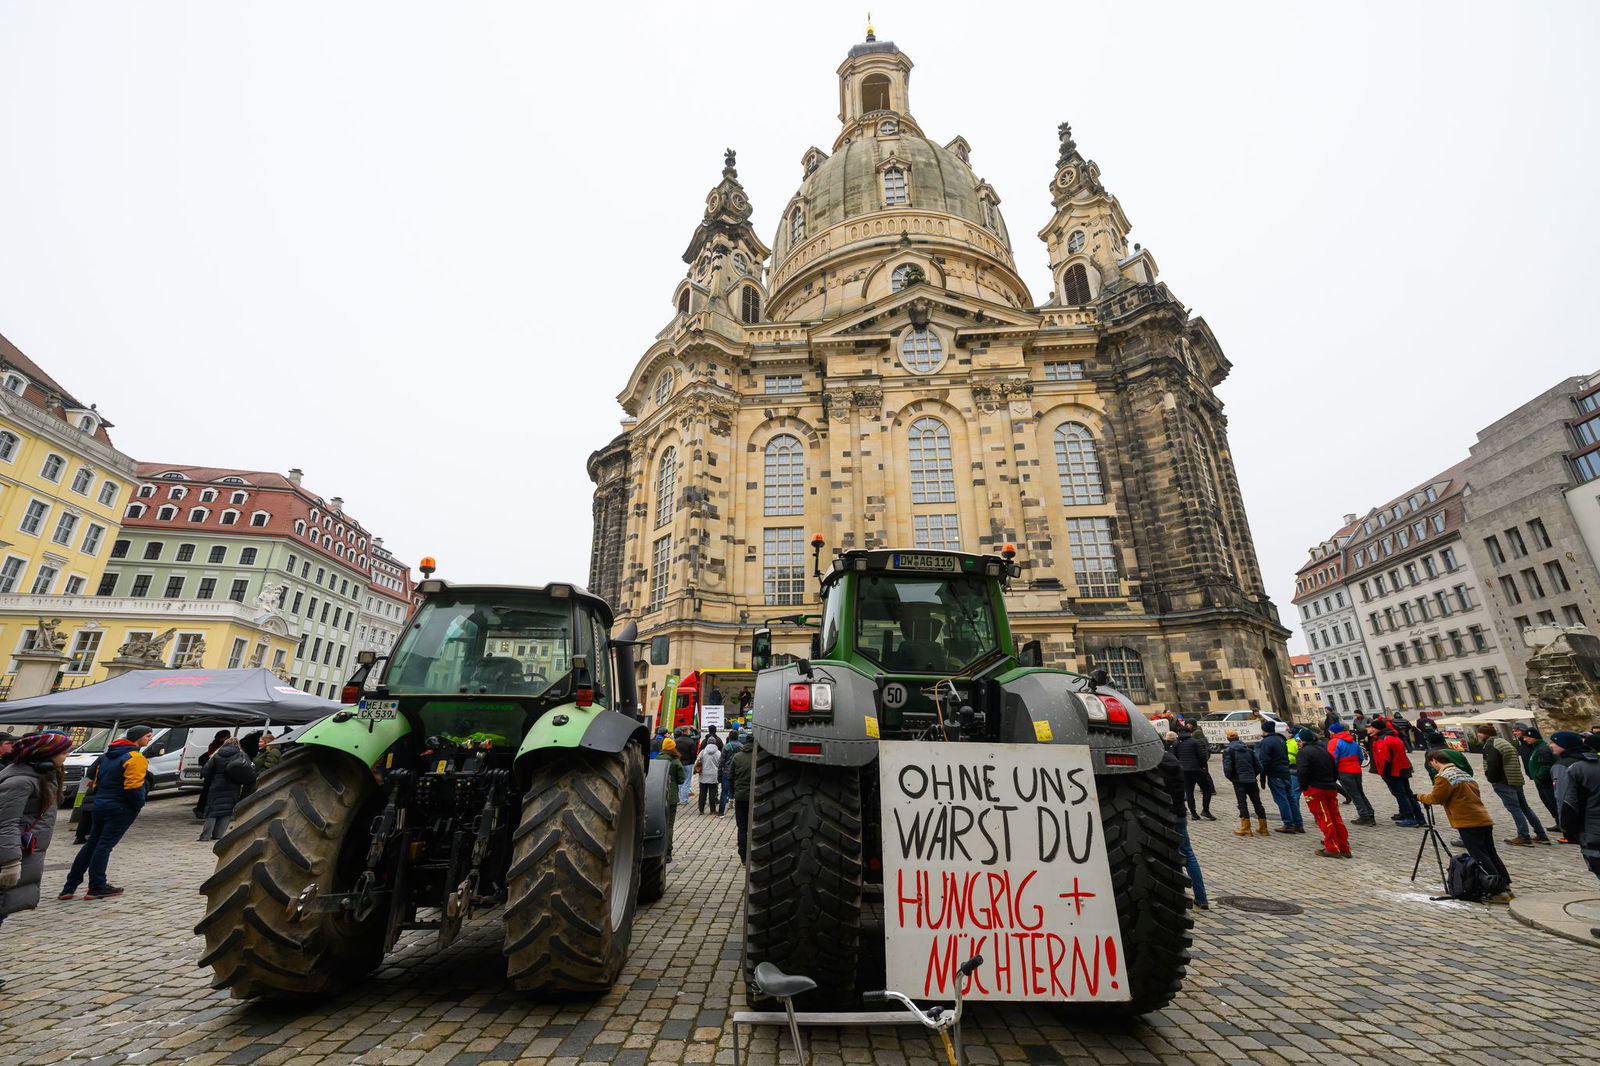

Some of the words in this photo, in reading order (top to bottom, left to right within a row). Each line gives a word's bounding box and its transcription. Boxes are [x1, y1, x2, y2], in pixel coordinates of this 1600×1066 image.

[900, 555, 914, 566] DW
[919, 556, 933, 567] AG
[934, 557, 953, 568] 116
[887, 687, 903, 704] 50
[898, 764, 1000, 802] OHNE
[1013, 766, 1089, 806] UNS
[894, 801, 1019, 865] WÄRST
[1037, 805, 1093, 864] DU
[897, 868, 1044, 931] HUNGRIG
[924, 932, 1120, 998] NÜCHTERN!
